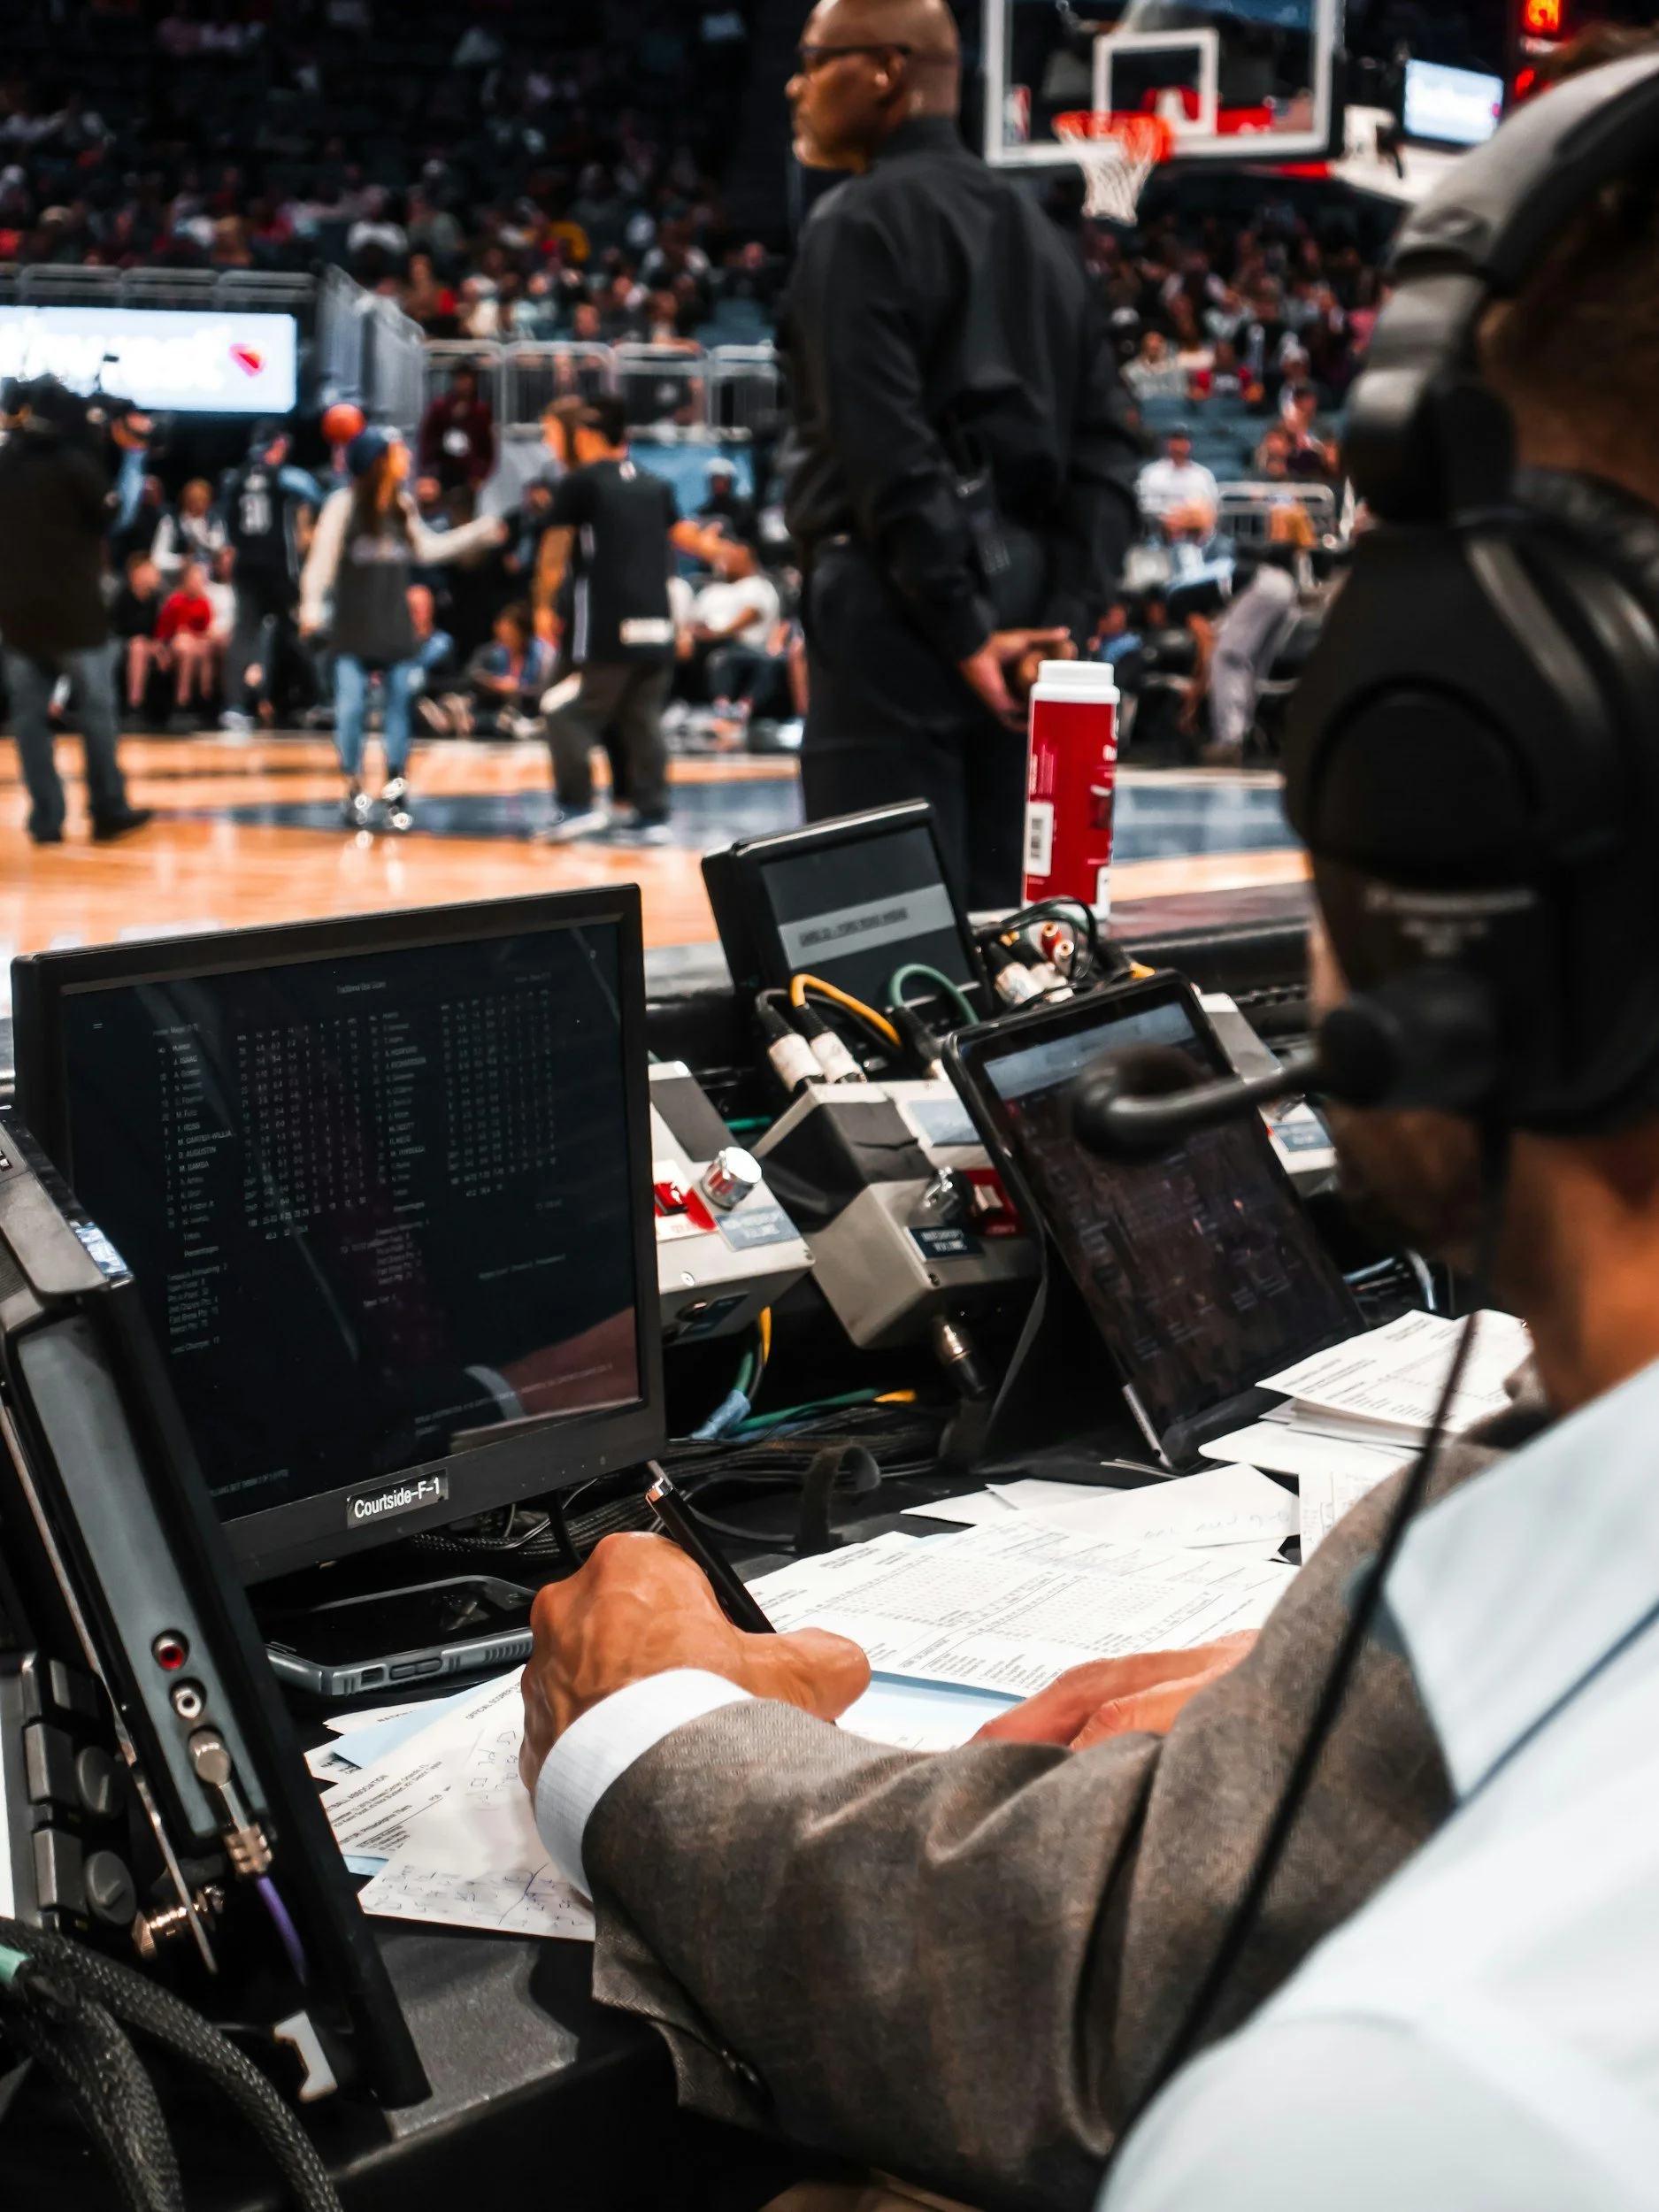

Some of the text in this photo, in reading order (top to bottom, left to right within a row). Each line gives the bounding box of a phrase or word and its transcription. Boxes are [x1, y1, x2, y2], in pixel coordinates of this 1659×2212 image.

[186, 1147, 216, 1158] AUGUSTIN
[354, 1477, 440, 1518] Courtside-F-1
[348, 1774, 388, 1800] ASSOCIATION
